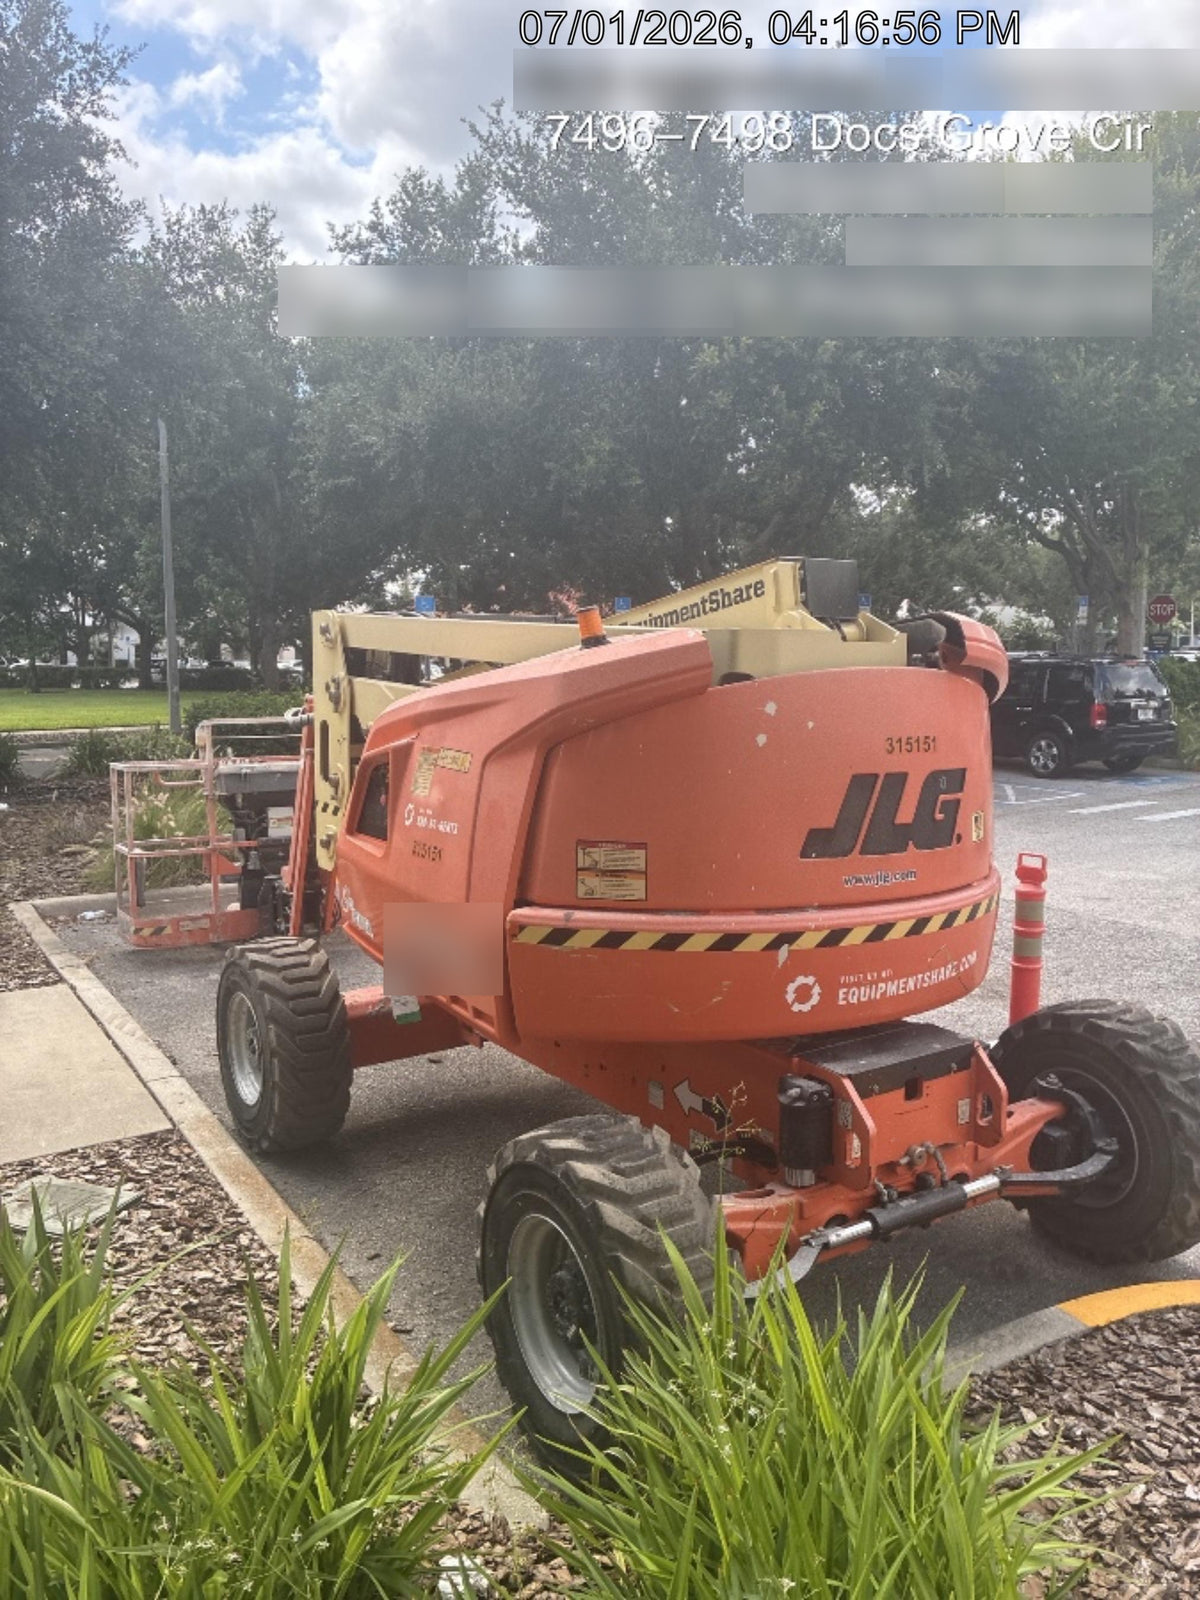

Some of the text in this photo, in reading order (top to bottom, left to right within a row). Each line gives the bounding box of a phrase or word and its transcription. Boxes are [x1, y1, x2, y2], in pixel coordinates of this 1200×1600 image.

[1149, 603, 1175, 616] STOP
[885, 735, 937, 754] 315151
[799, 767, 967, 860] JLG
[843, 869, 917, 888] www.jlg.com
